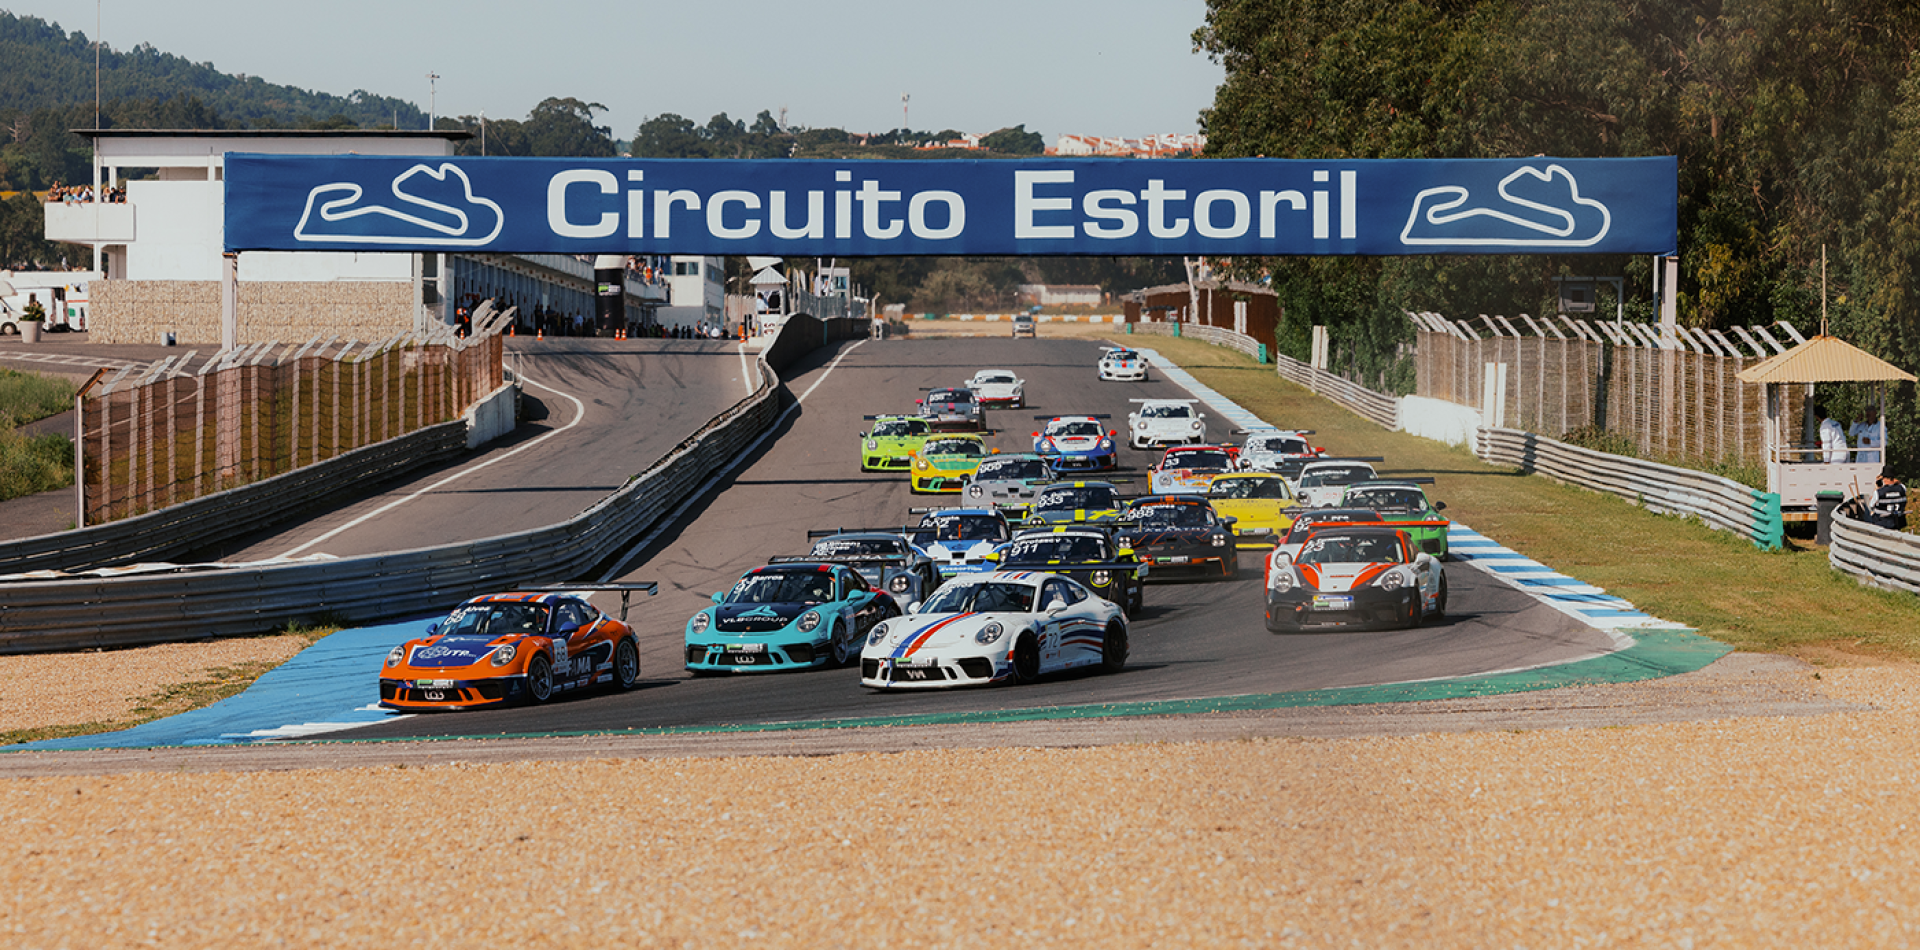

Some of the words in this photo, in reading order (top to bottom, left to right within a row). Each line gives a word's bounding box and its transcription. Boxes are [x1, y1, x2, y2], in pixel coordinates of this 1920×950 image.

[547, 169, 966, 240] Circuito
[1015, 170, 1357, 239] Estoril
[1010, 543, 1039, 557] 911
[1048, 632, 1058, 648] 72
